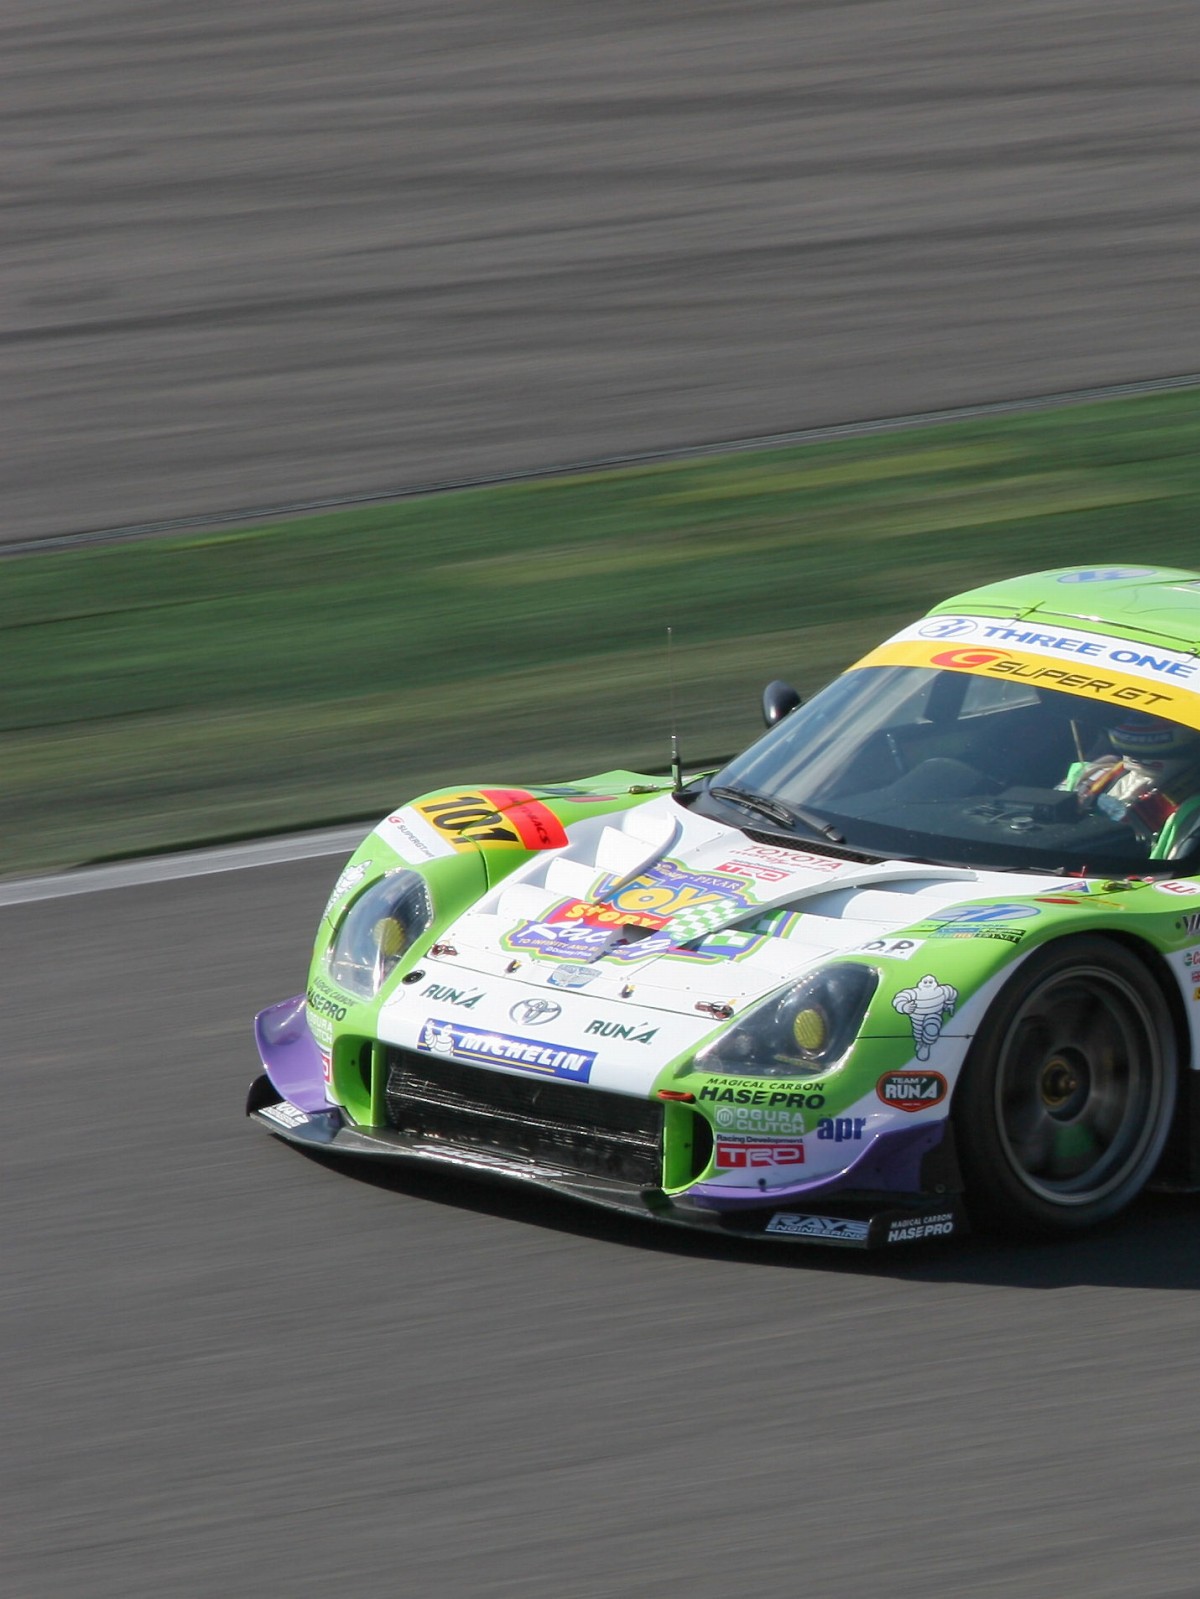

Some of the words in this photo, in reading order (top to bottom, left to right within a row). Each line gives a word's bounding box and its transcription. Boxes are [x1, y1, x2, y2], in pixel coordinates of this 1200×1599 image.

[983, 626, 1108, 656] THREE
[1108, 650, 1198, 679] ONE
[987, 660, 1117, 693] SUPER
[1110, 687, 1174, 705] GT
[421, 796, 519, 844] 101
[745, 845, 844, 871] TOYOTA
[693, 874, 742, 892] PIXAR
[611, 876, 727, 916] TOY
[565, 903, 661, 928] STORY
[516, 918, 672, 957] Racg
[568, 943, 588, 951] AND
[458, 1032, 588, 1072] MICHELIN
[706, 1078, 767, 1089] MAGICAL
[769, 1082, 825, 1092] CARBON
[736, 1108, 805, 1123] OGURA
[736, 1120, 805, 1134] CLUTCH
[716, 1134, 745, 1143] Racing
[746, 1135, 803, 1145] Development
[816, 1116, 866, 1142] apr
[769, 1213, 869, 1234] RAYS
[890, 1217, 922, 1229] MAGICAL
[924, 1212, 953, 1224] CARBON
